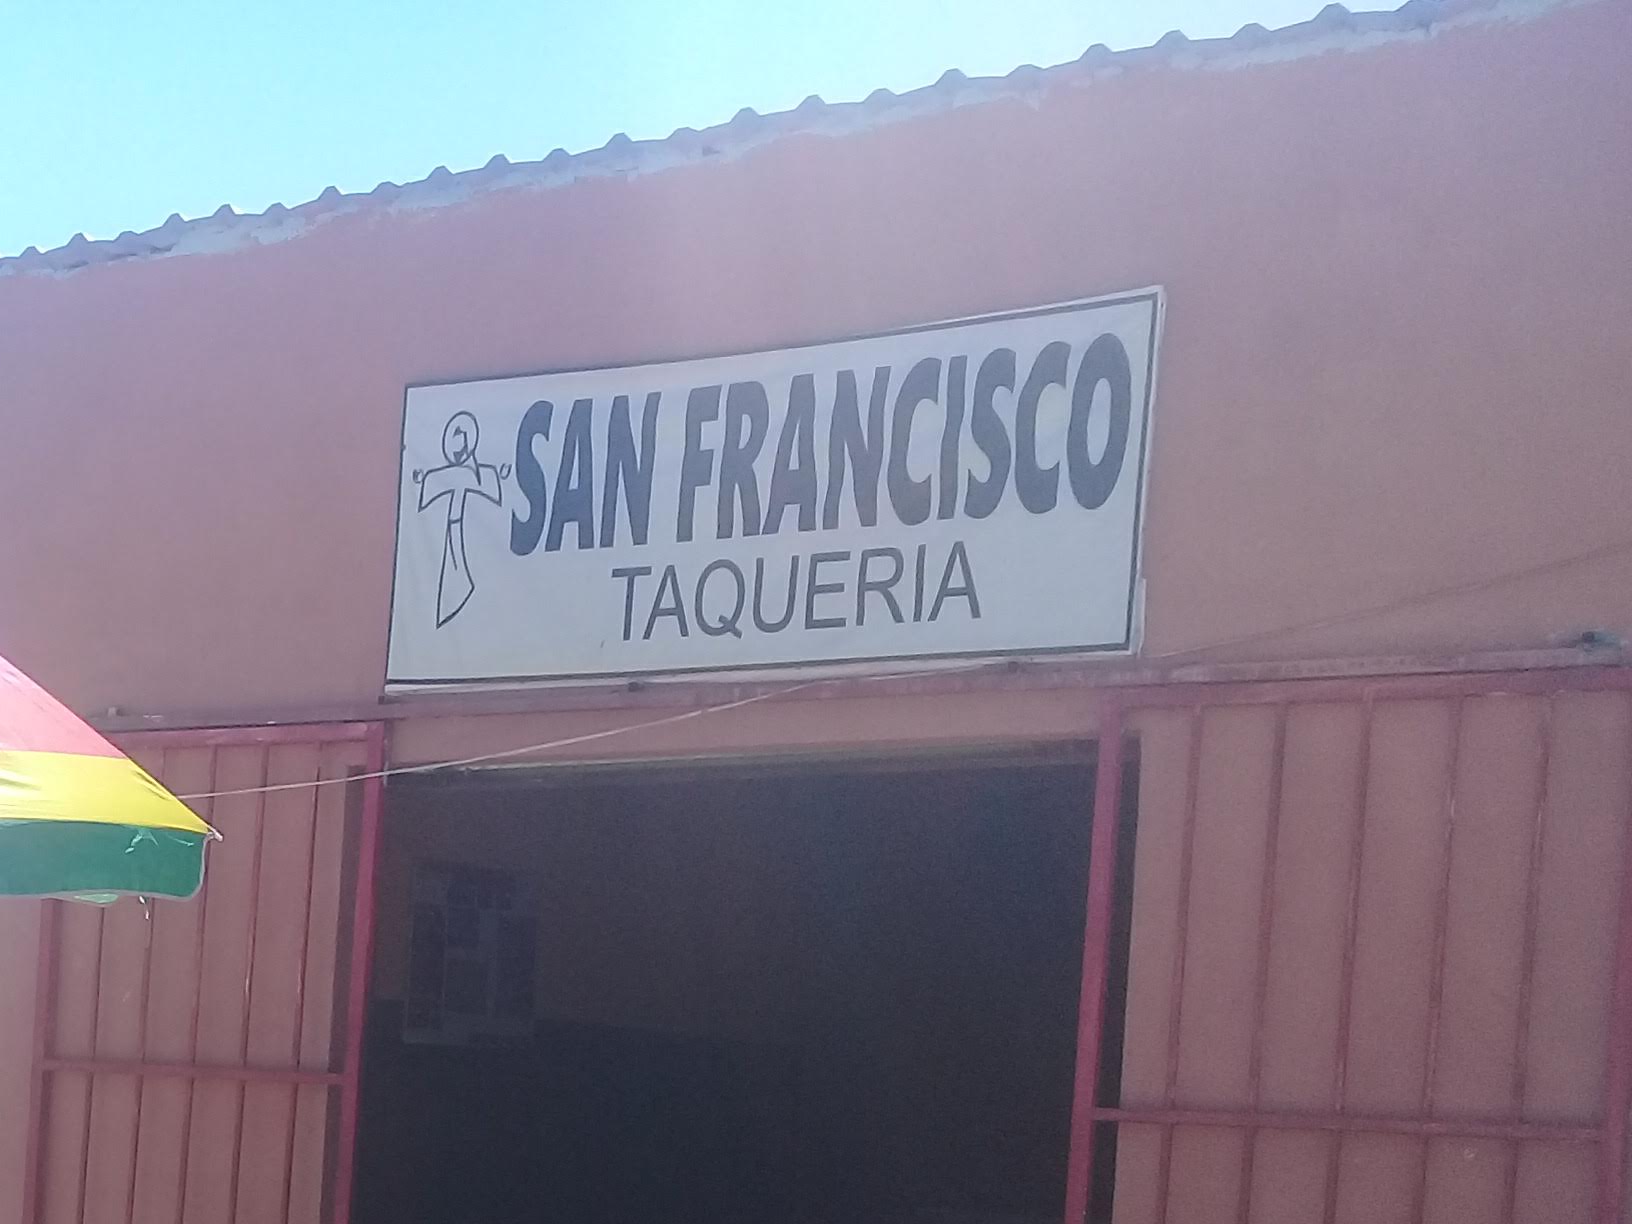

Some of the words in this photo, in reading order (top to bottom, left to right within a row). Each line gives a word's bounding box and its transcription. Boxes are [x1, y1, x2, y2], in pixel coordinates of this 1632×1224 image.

[510, 391, 661, 555] SAN
[675, 332, 1132, 543] FRANCISCO
[611, 541, 981, 641] TAQUERIA
